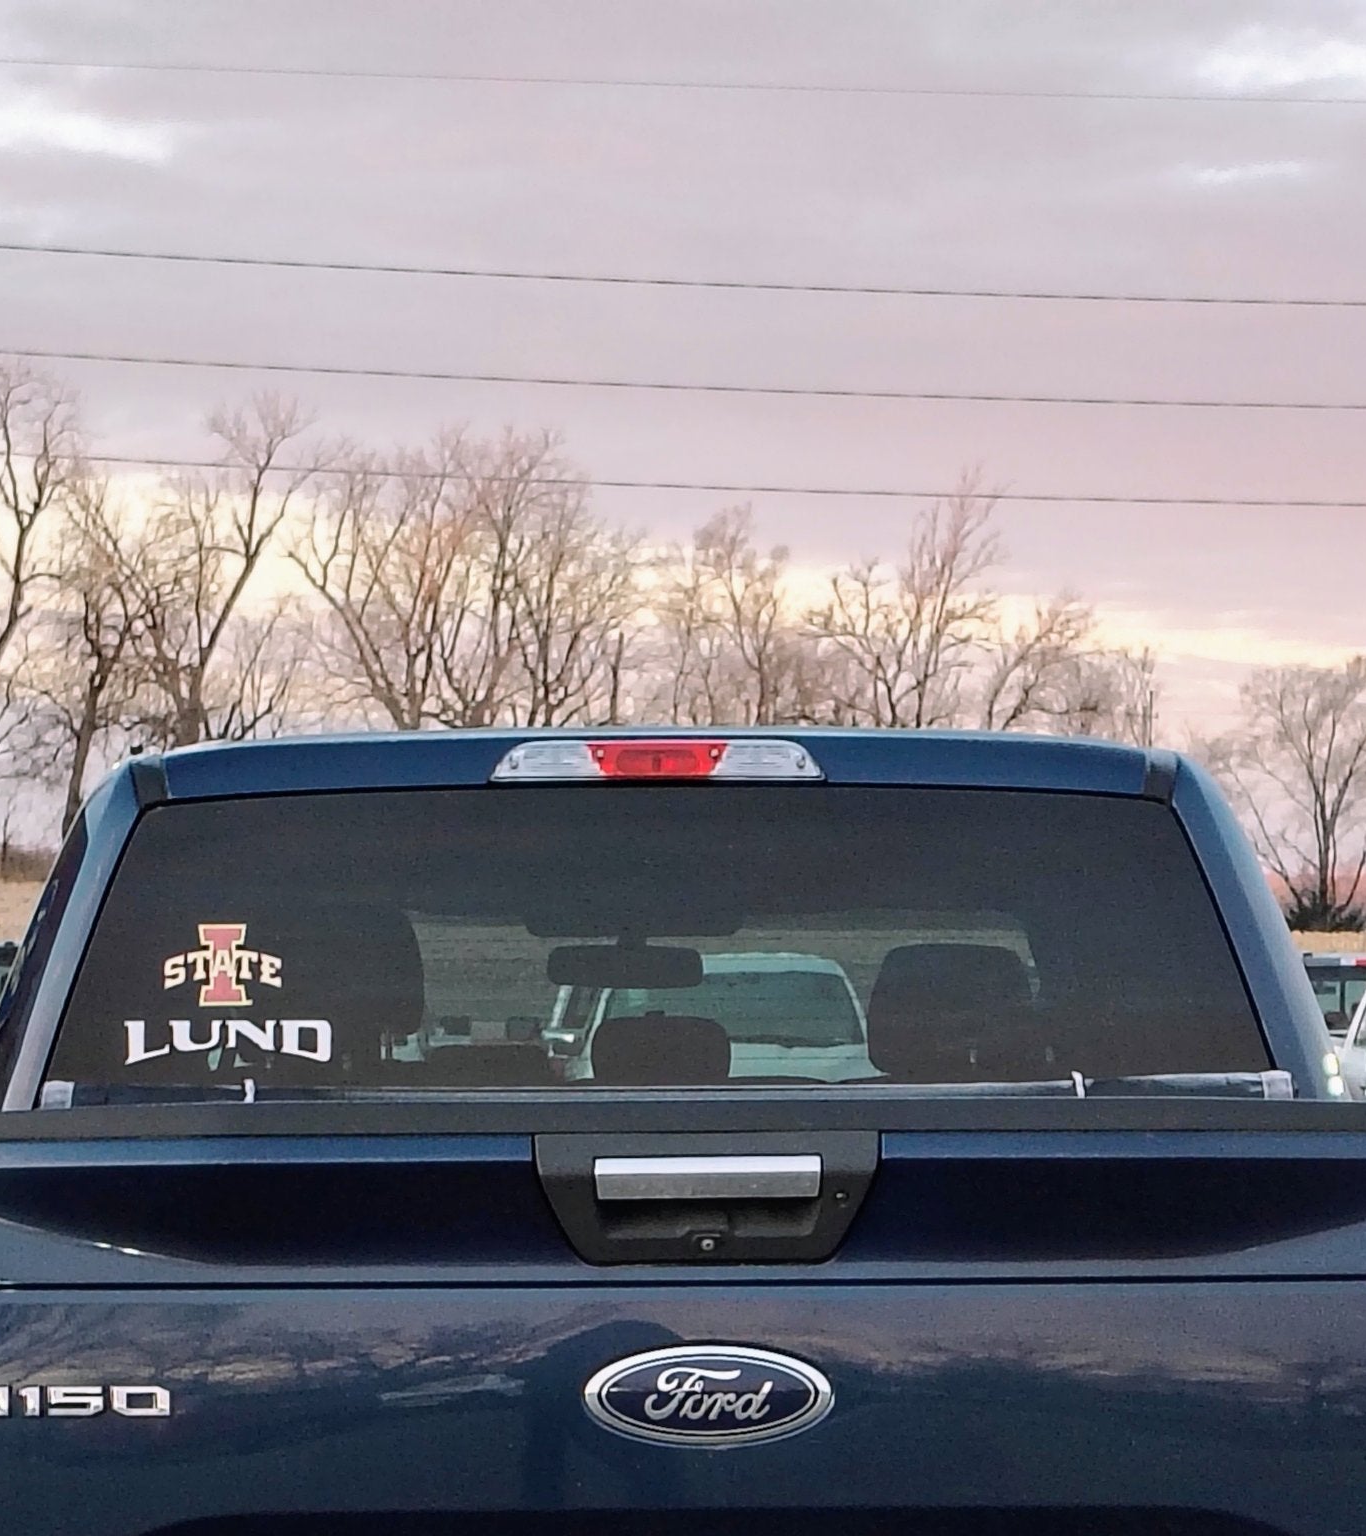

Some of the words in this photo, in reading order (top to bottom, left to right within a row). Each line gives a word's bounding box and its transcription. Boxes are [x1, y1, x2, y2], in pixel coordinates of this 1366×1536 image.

[163, 950, 283, 990] STATE
[123, 1019, 333, 1066] LUND
[643, 1366, 774, 1421] Ford
